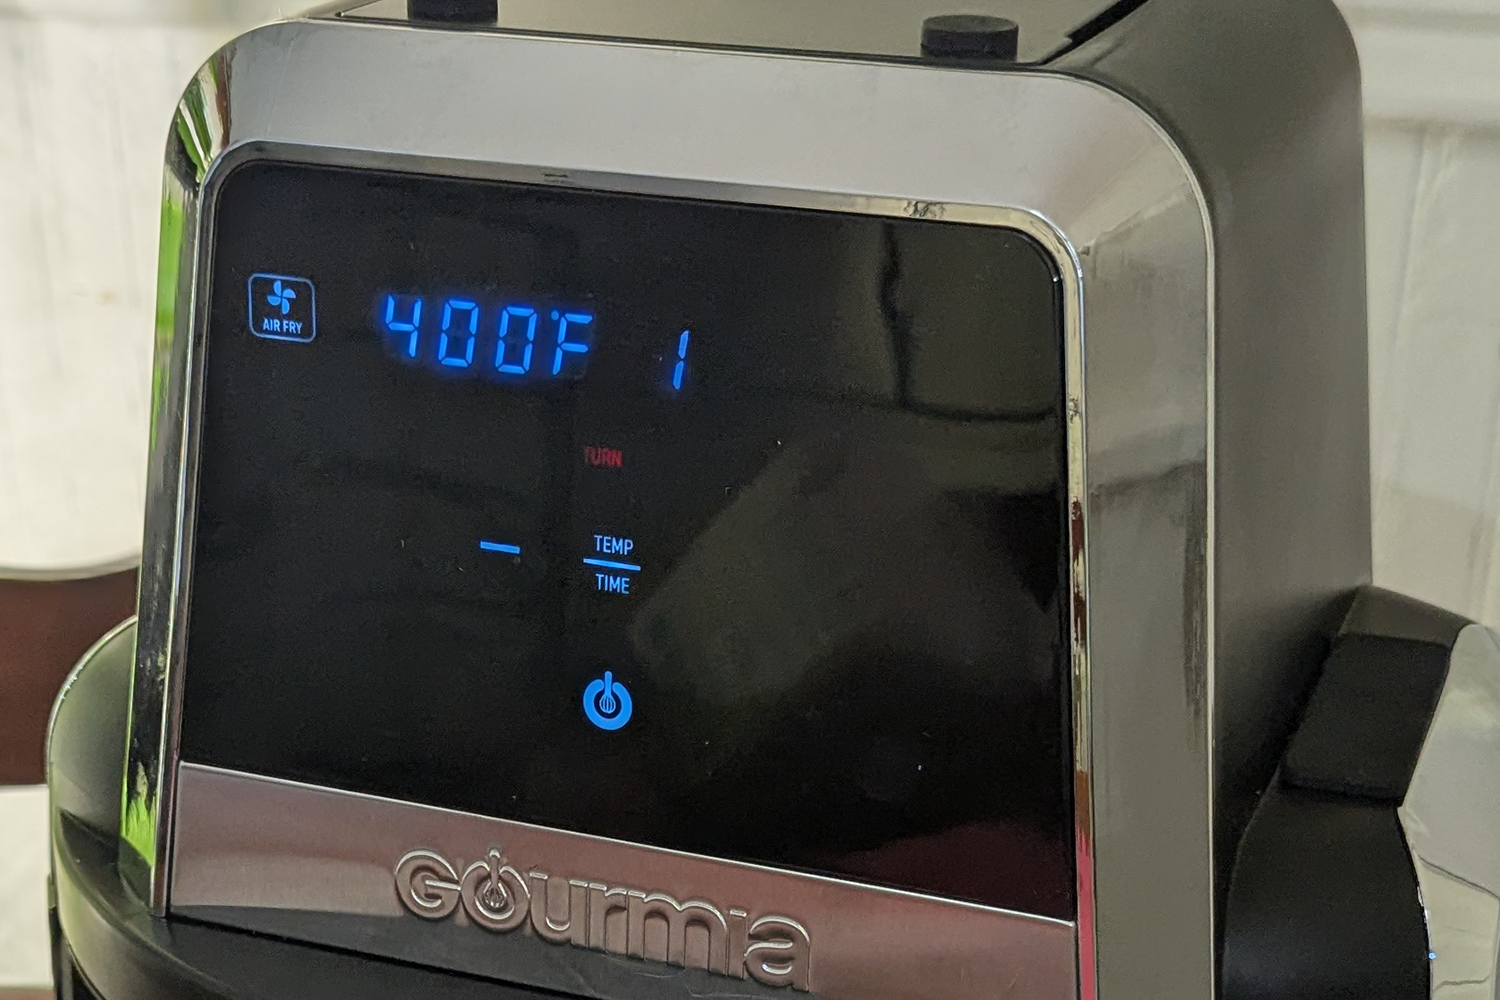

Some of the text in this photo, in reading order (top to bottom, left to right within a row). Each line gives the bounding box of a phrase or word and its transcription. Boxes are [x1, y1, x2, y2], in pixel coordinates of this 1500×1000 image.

[262, 316, 303, 335] AIR FRY
[583, 445, 623, 468] TURN
[594, 534, 634, 556] TEMP
[595, 573, 631, 595] TIME
[394, 847, 812, 993] Gourmia
